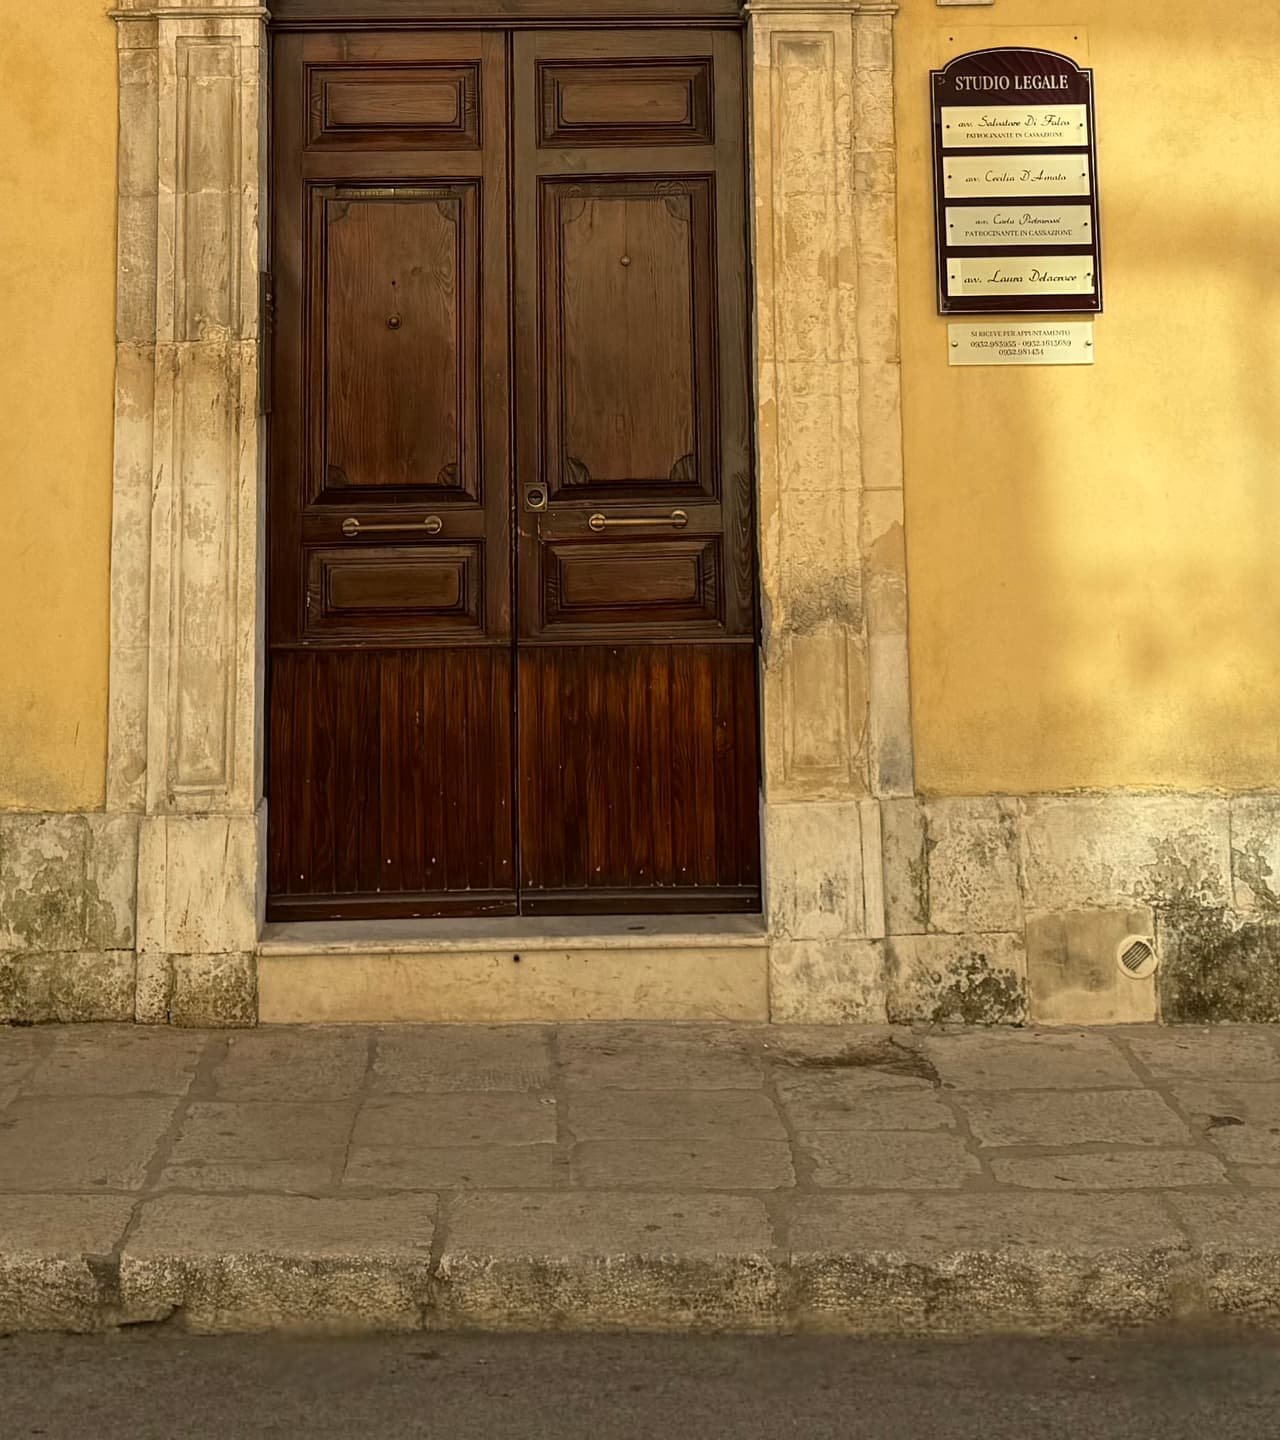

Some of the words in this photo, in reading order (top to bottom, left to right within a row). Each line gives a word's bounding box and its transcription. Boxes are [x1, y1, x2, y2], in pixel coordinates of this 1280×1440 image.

[955, 75, 1010, 91] STUDIO
[1014, 74, 1069, 90] LEGALE
[978, 115, 1021, 128] Salvatore
[965, 229, 1019, 237] PATROCINANTE
[1028, 229, 1073, 237] CASSAZIONE
[987, 269, 1023, 284] Laura
